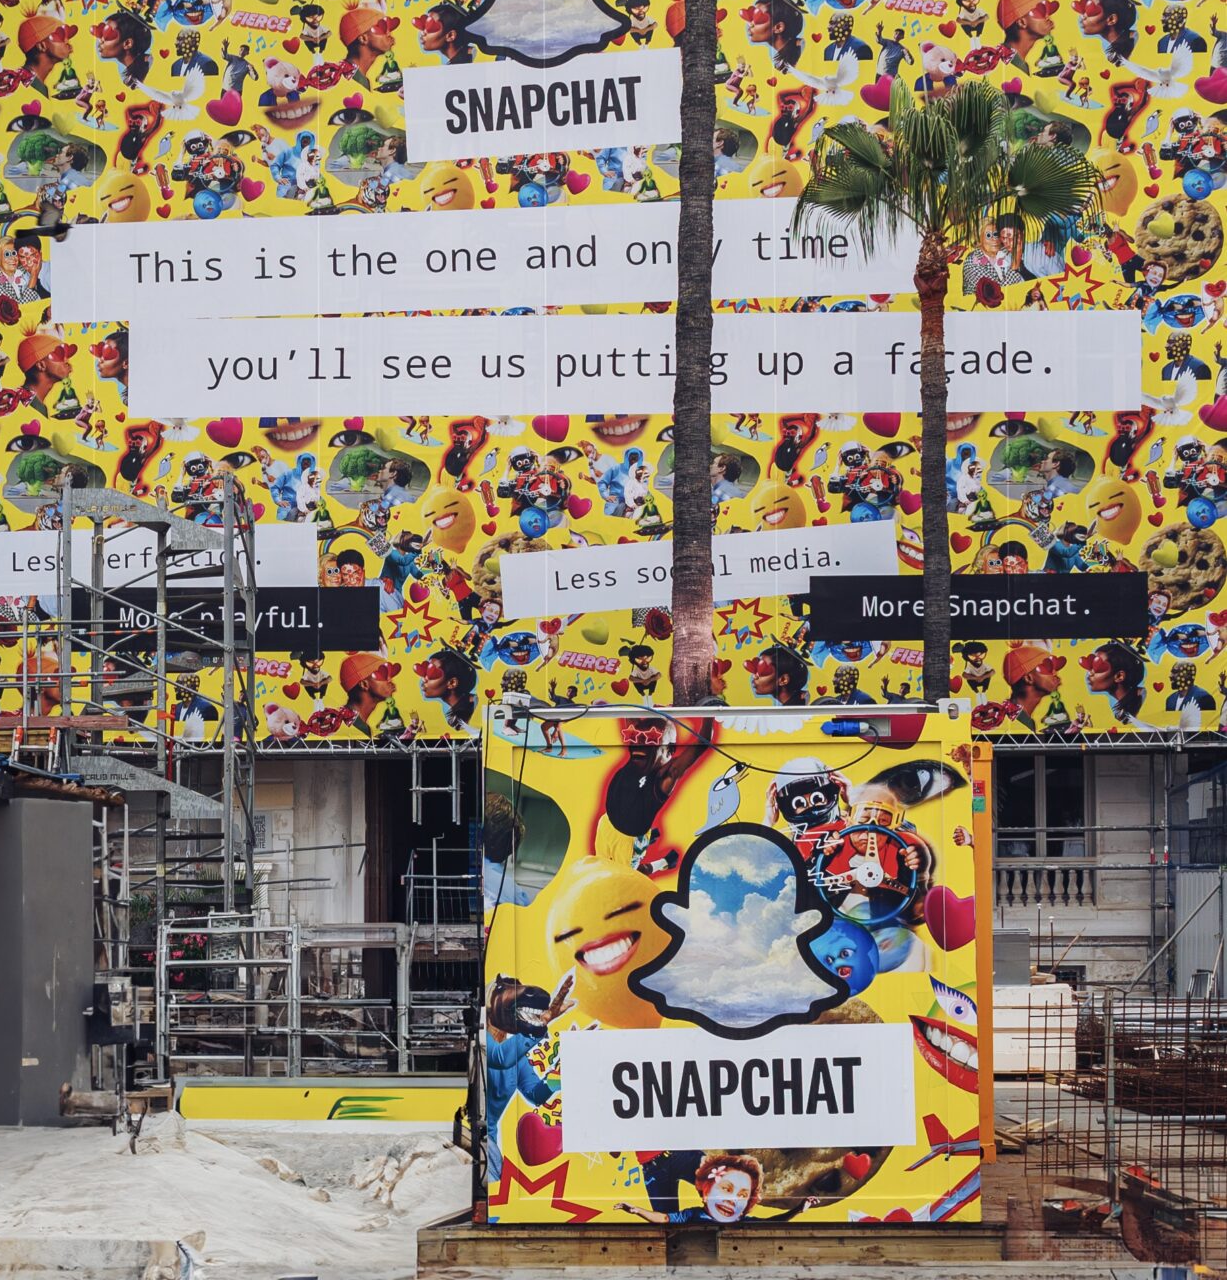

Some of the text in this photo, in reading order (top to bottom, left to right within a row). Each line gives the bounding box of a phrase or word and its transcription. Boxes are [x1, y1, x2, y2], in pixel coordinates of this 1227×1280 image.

[231, 11, 293, 34] FIERCE
[445, 76, 641, 135] SNAPCHAT
[130, 229, 852, 284] This is the one and on time
[208, 347, 352, 391] you’ll
[383, 356, 452, 380] see
[481, 355, 525, 379] us
[557, 344, 729, 387] puttig
[758, 352, 804, 386] up
[833, 352, 853, 376] a
[555, 570, 617, 591] Less
[751, 548, 841, 574] media.
[862, 593, 1090, 622] More Snapchat.
[557, 651, 620, 675] FIERCE
[612, 1056, 862, 1119] SNAPCHAT
